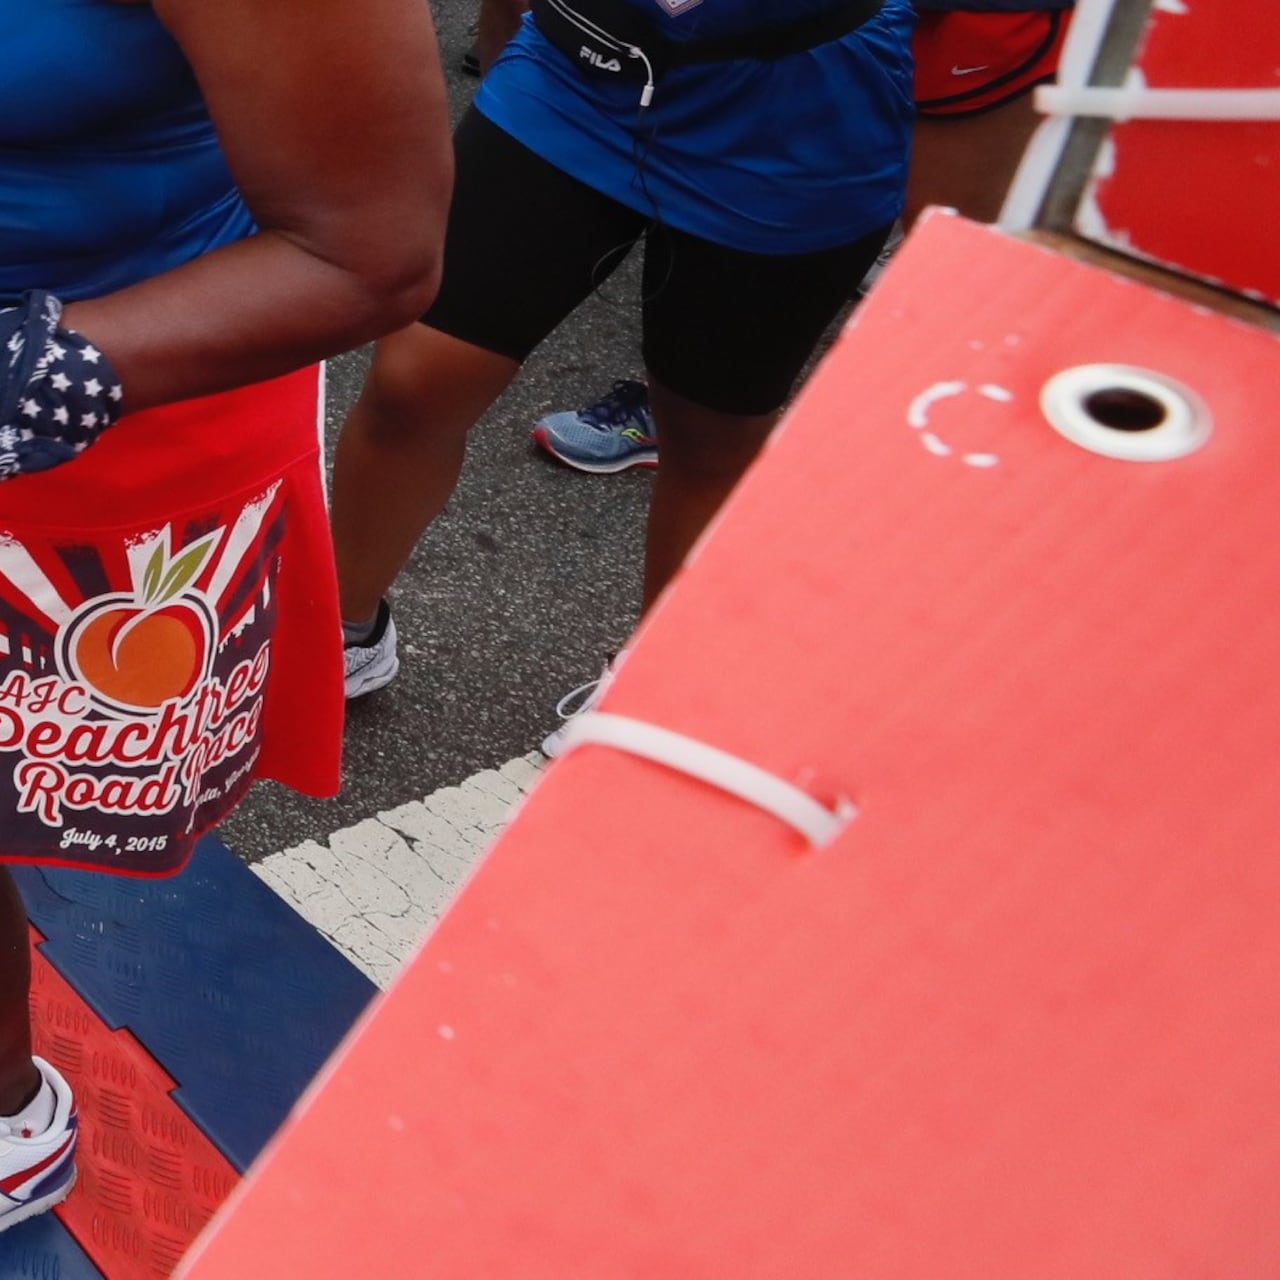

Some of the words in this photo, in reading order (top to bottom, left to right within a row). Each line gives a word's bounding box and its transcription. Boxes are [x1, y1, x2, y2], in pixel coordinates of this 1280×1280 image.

[580, 45, 621, 72] FILA
[15, 759, 181, 827] Road
[59, 827, 104, 850] July
[104, 833, 122, 854] 4,
[127, 835, 168, 852] 2015
